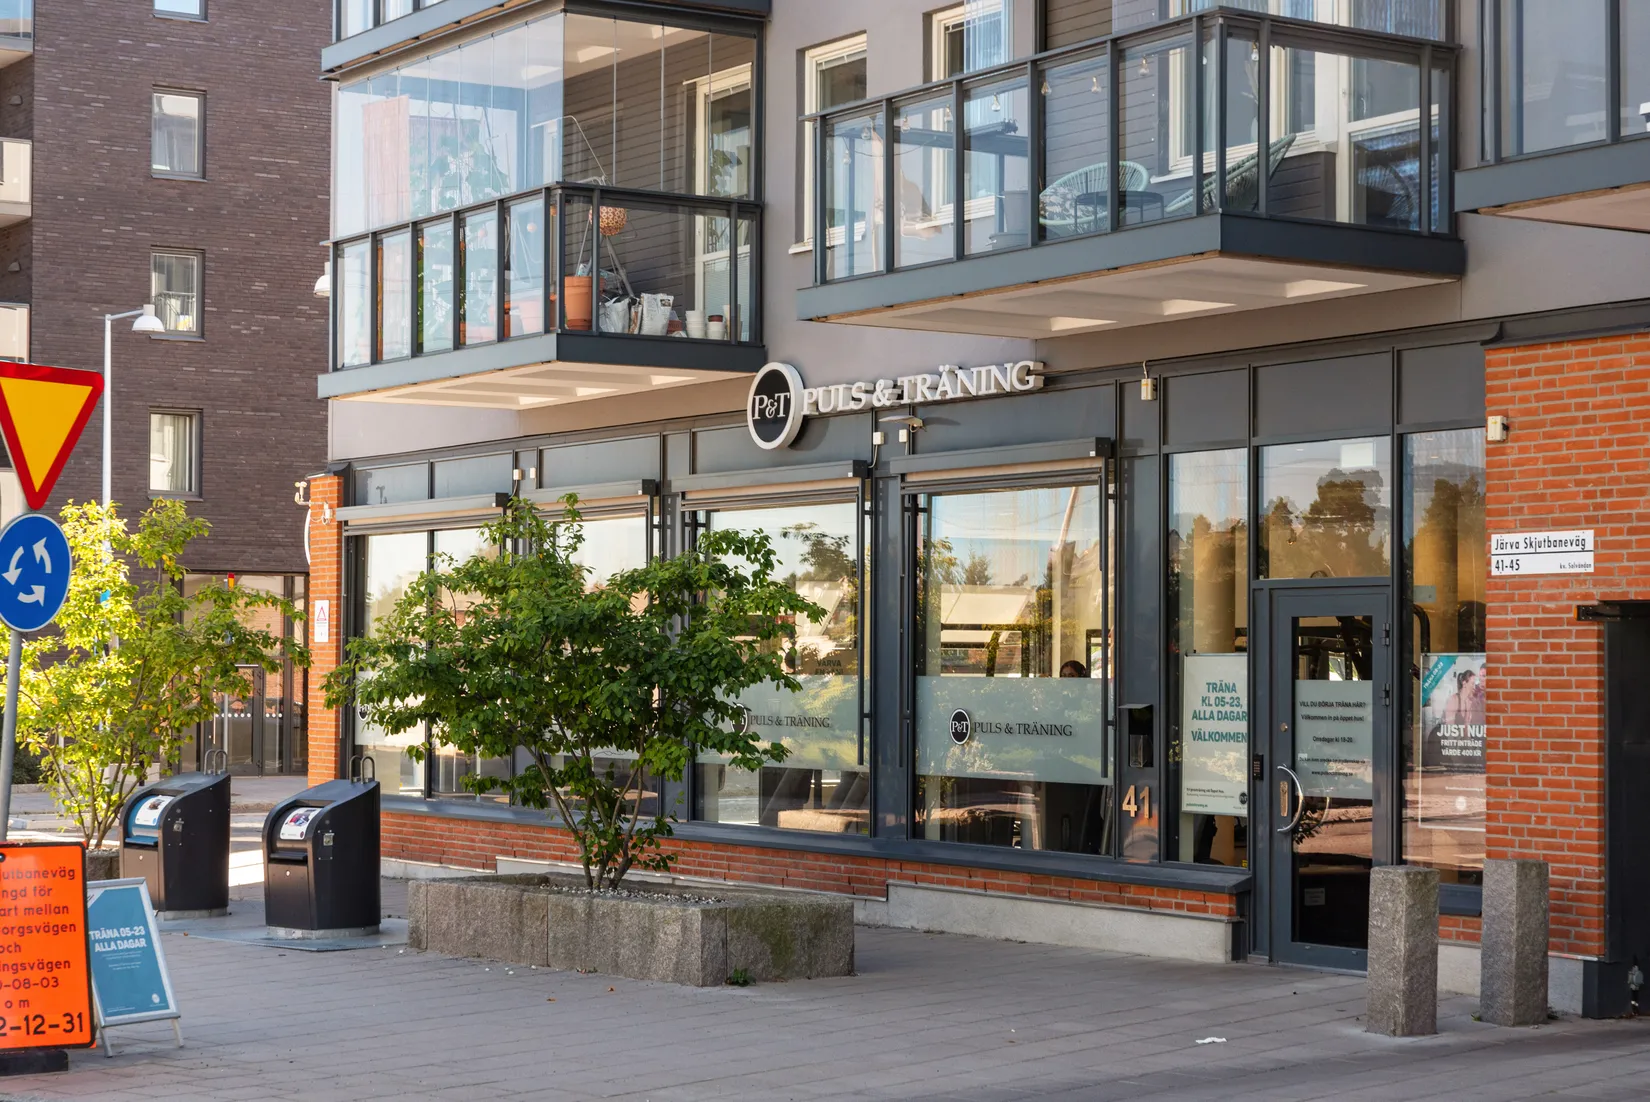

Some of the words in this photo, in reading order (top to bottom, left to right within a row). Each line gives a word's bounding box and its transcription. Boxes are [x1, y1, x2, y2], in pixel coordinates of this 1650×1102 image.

[801, 381, 867, 415] PULS
[872, 378, 896, 407] &
[897, 360, 1041, 404] TRÄNING
[752, 392, 790, 420] P&T
[1495, 538, 1520, 550] Järva
[1523, 535, 1586, 552] Skjutbaneväg
[1495, 559, 1520, 571] 41-45
[1206, 680, 1237, 694] TRÄNA
[1201, 696, 1213, 707] KL
[1214, 696, 1243, 709] 05-23,
[750, 715, 774, 726] PULS
[774, 715, 783, 726] &
[784, 714, 831, 728] TRÄNING
[1191, 709, 1215, 721] ALLA
[1216, 710, 1248, 722] DAGAR
[951, 721, 968, 733] P&T
[974, 721, 1002, 734] PULS
[1004, 722, 1014, 735] &
[1016, 722, 1073, 737] TRÄNING
[1437, 724, 1465, 737] JUST
[1467, 725, 1487, 738] NU!
[1191, 728, 1248, 743] VÄLKOMMEN
[1441, 739, 1457, 747] FRITT
[1441, 748, 1461, 756] VÄRDE
[1122, 784, 1150, 819] 41
[0, 866, 76, 881] utbaneväg
[23, 903, 70, 916] mellan
[89, 928, 120, 940] TRÄNA
[120, 926, 146, 937] 05-23
[94, 941, 118, 953] ALLA
[117, 938, 148, 950] DAGAR
[0, 958, 71, 975] ngsvägen
[0, 976, 59, 990] -08-03
